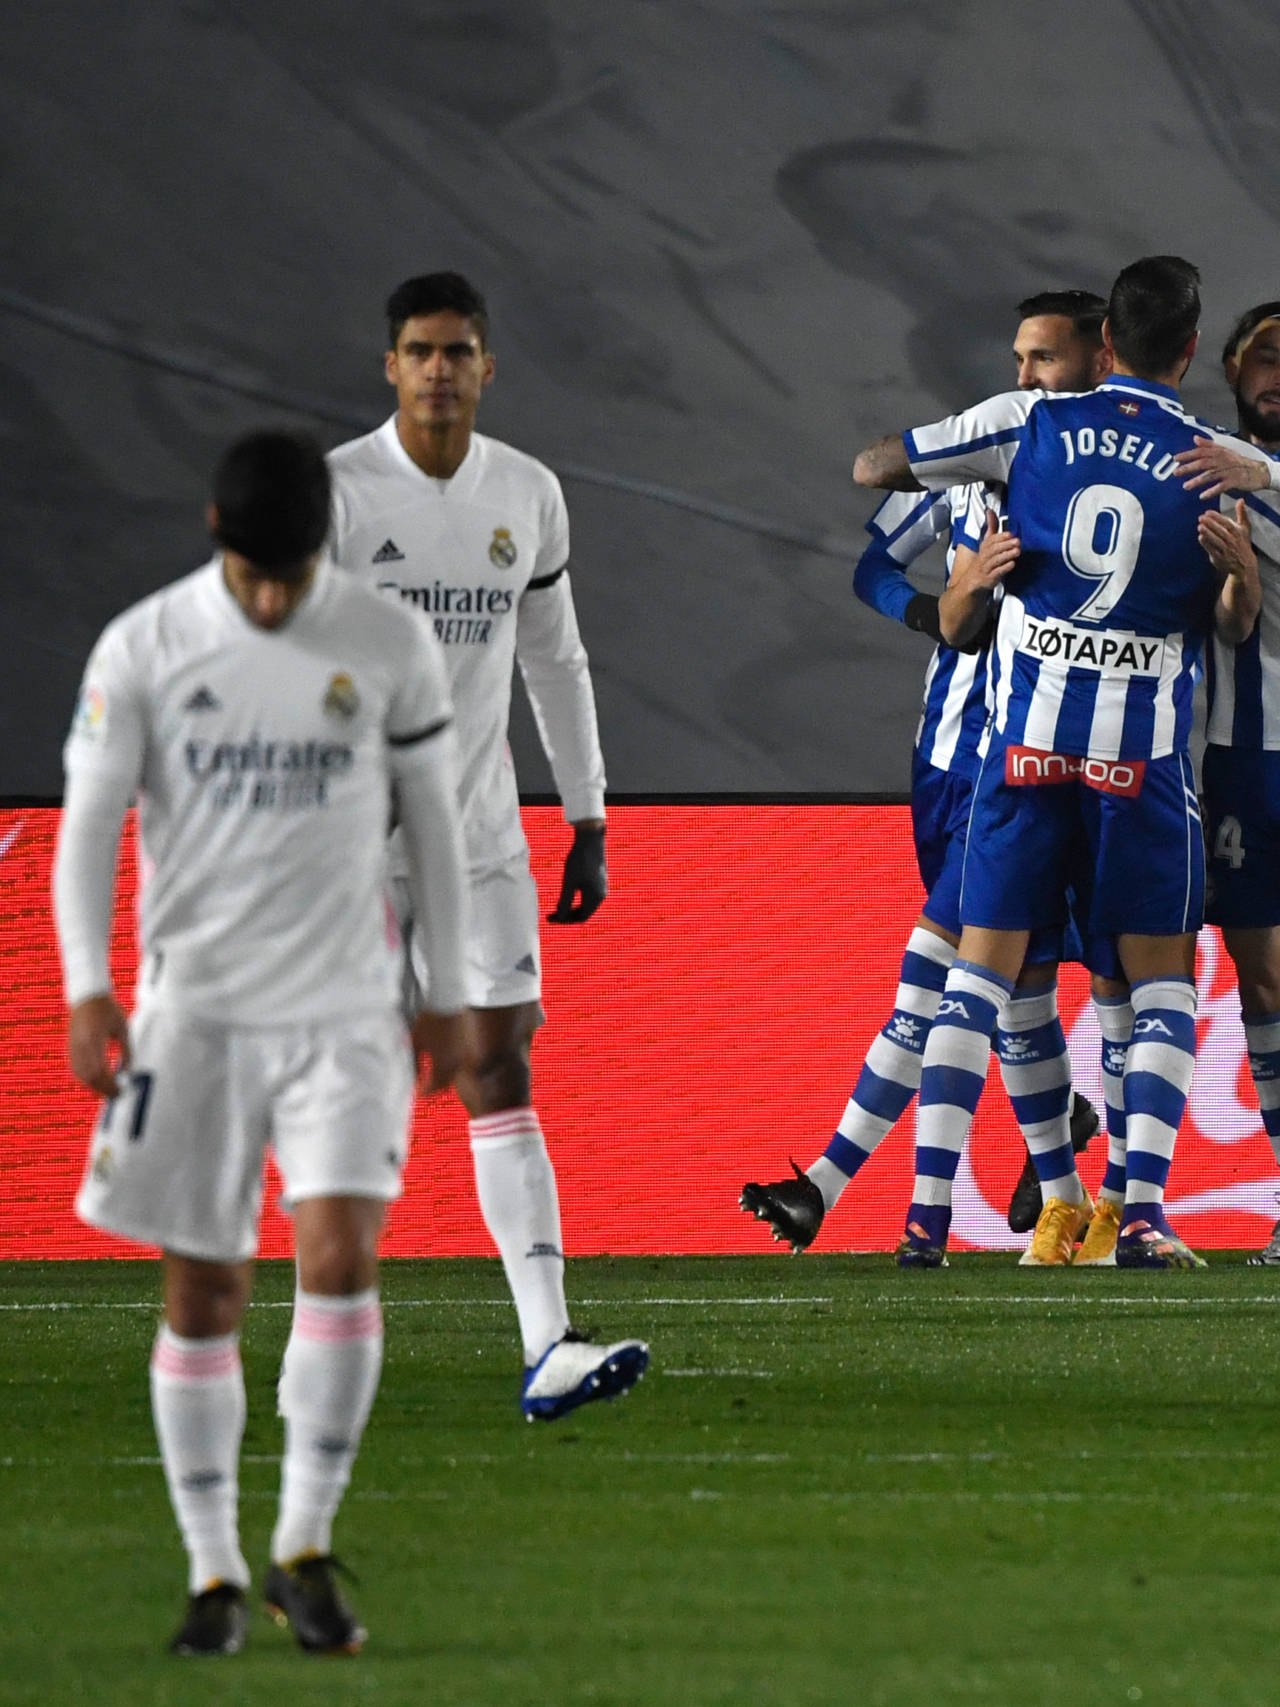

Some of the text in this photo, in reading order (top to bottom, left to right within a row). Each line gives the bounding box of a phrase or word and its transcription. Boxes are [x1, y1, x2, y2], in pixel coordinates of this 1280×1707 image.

[1060, 427, 1180, 481] JOSELU
[1062, 484, 1144, 623] 9
[377, 580, 513, 613] mirates
